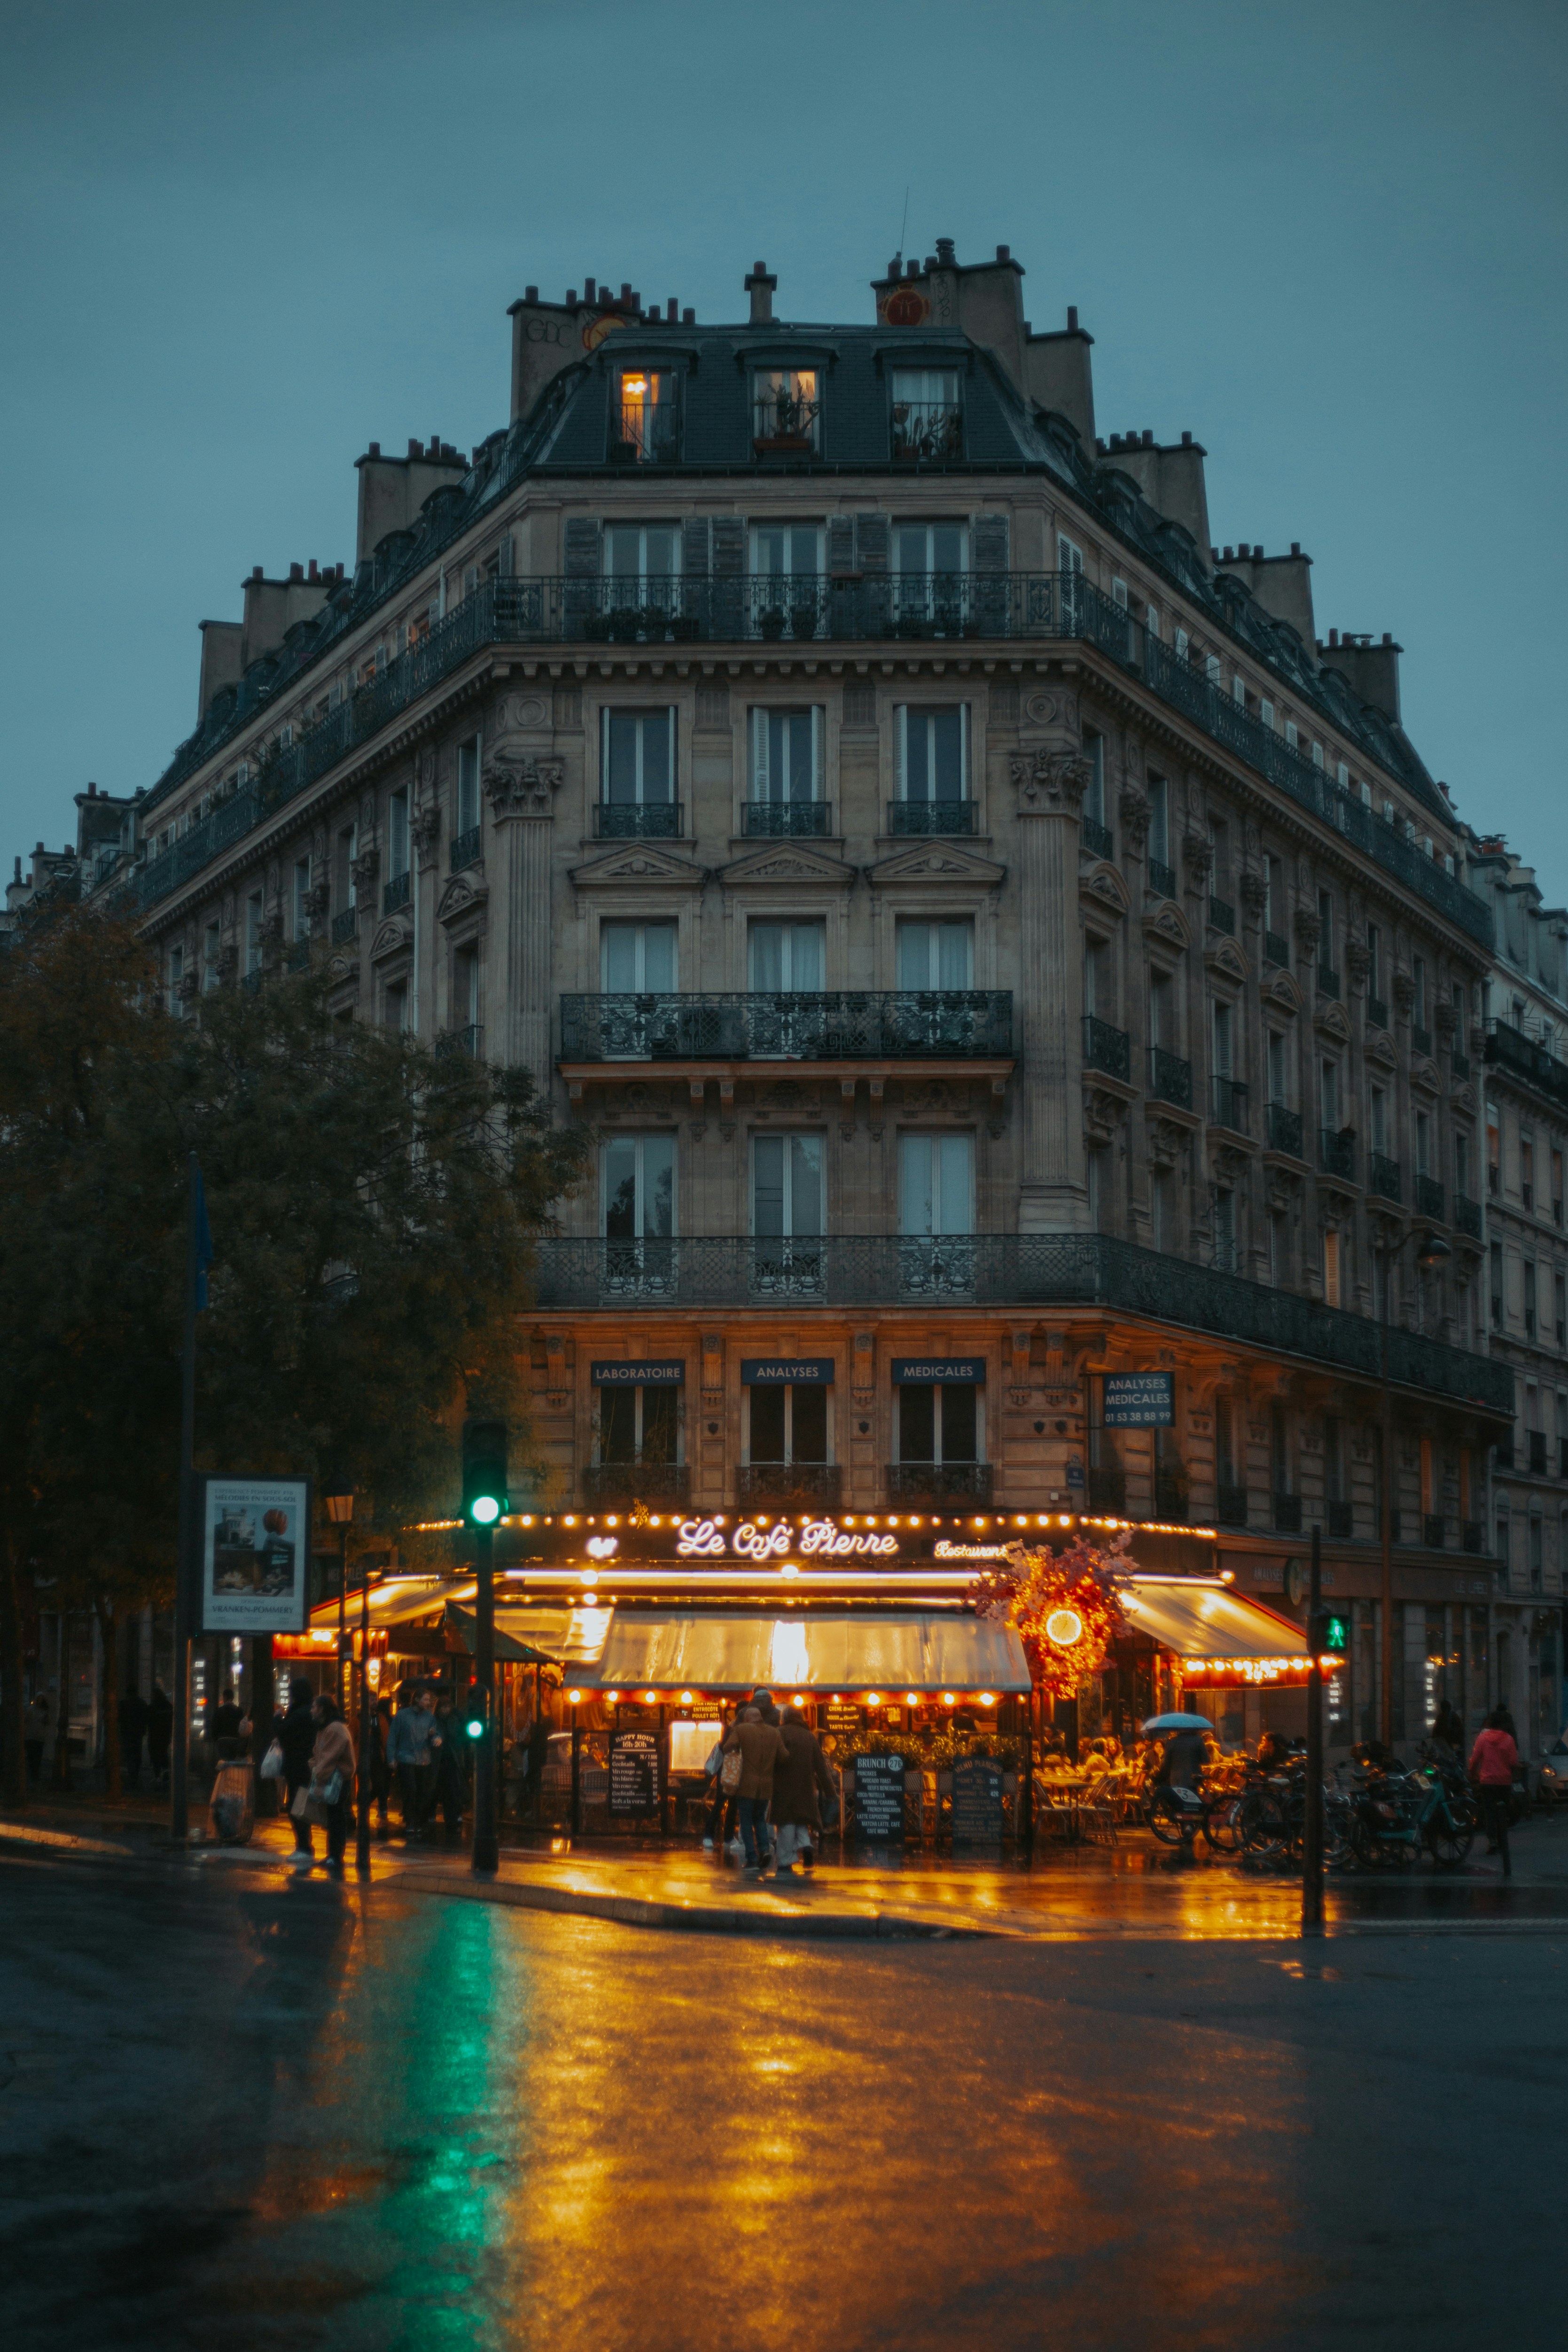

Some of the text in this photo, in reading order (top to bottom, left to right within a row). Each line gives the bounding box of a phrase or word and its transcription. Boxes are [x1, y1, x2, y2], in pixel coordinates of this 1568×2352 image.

[526, 319, 573, 348] GDC
[596, 1367, 680, 1379] LABORATOIRE
[756, 1367, 819, 1377] ANALYSES
[904, 1366, 973, 1377] MEDICALES
[1108, 1378, 1167, 1390] ANALYSES
[1106, 1393, 1170, 1405] MEDICALES
[1105, 1412, 1170, 1422] 01 53 38 88 99
[677, 1521, 899, 1560] Le Café Pierre
[934, 1540, 1008, 1559] Restaurant
[615, 1734, 655, 1743] HAPPY HOUR
[857, 1758, 886, 1768] BRUNCH
[955, 1760, 973, 1774] MENU
[1181, 1790, 1188, 1800] 3
